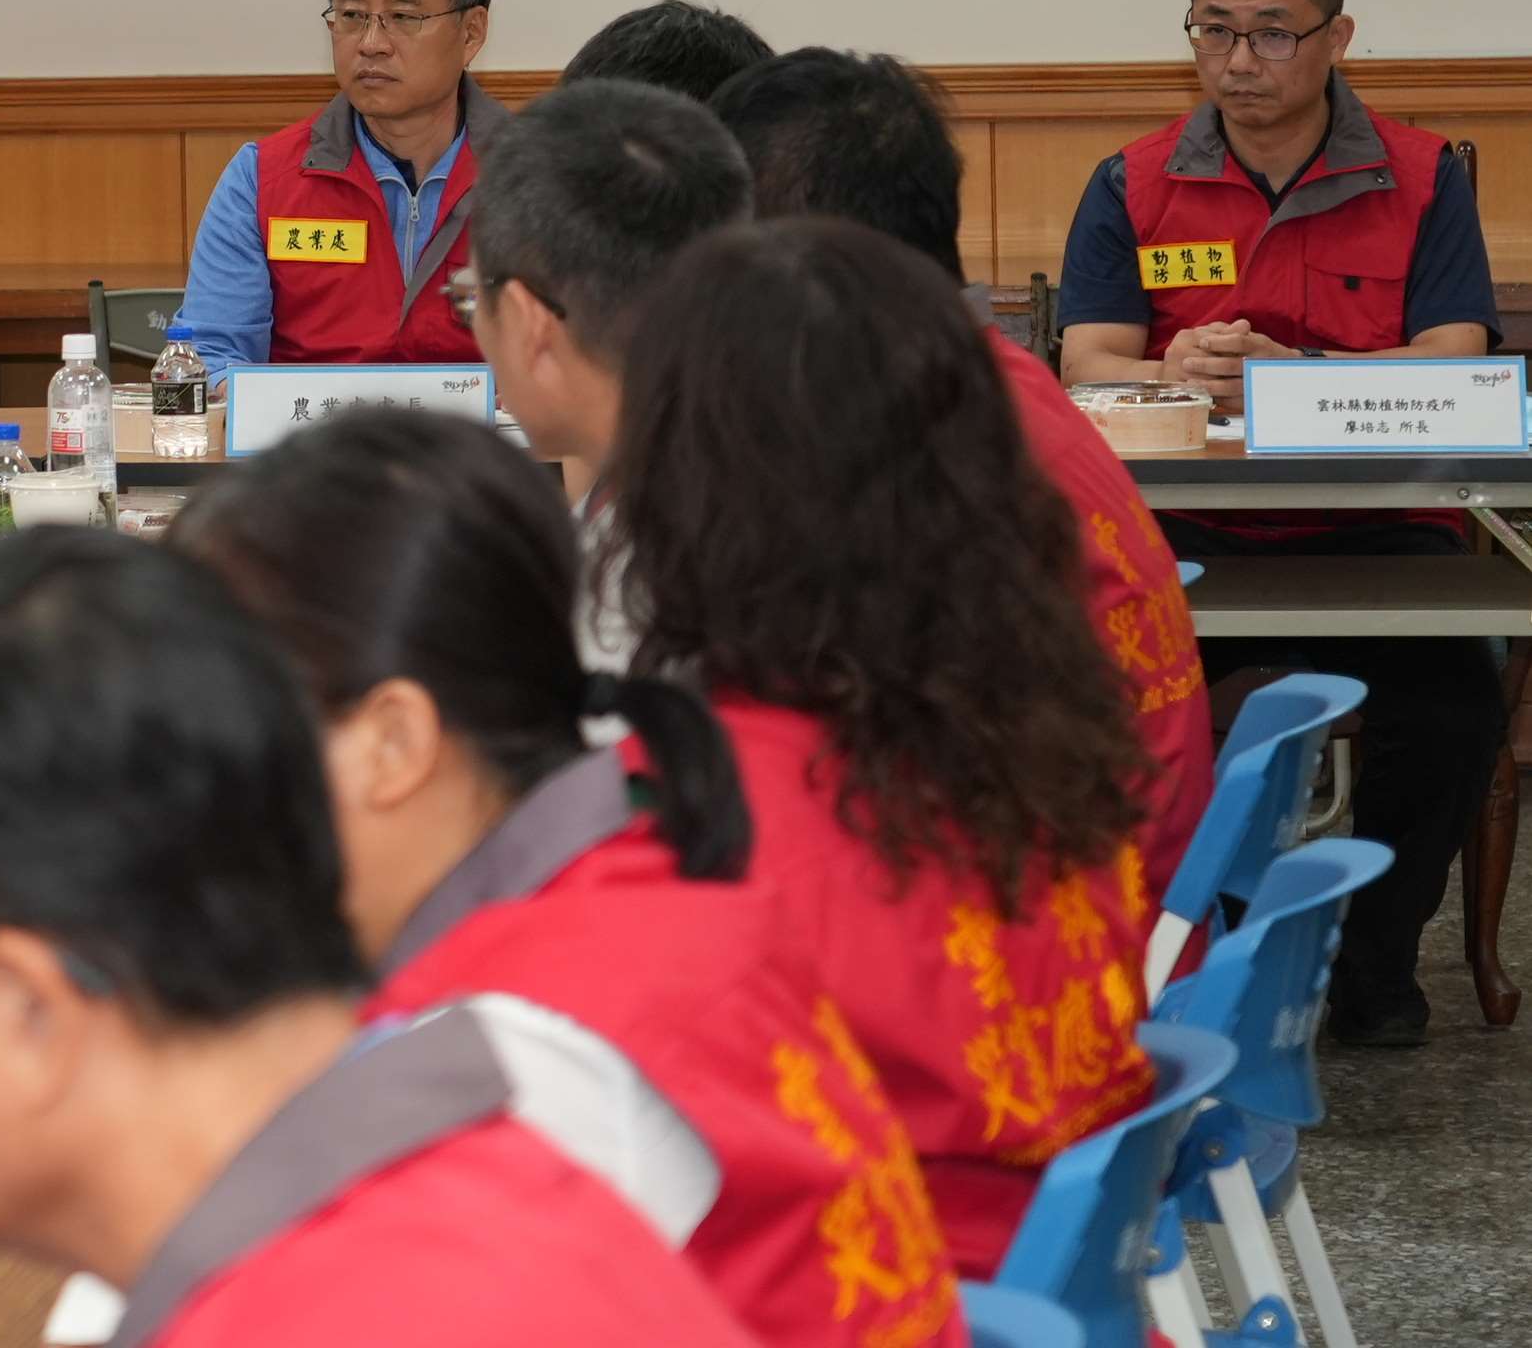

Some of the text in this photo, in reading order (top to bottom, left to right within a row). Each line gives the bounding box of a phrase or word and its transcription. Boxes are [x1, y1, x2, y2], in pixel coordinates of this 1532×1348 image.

[286, 227, 349, 252] 農業處
[1151, 246, 1223, 267] 動植物
[1153, 264, 1225, 285] 防疫所
[1317, 398, 1456, 413] 雲林縣動植物防疫所
[1399, 420, 1430, 434] 所長
